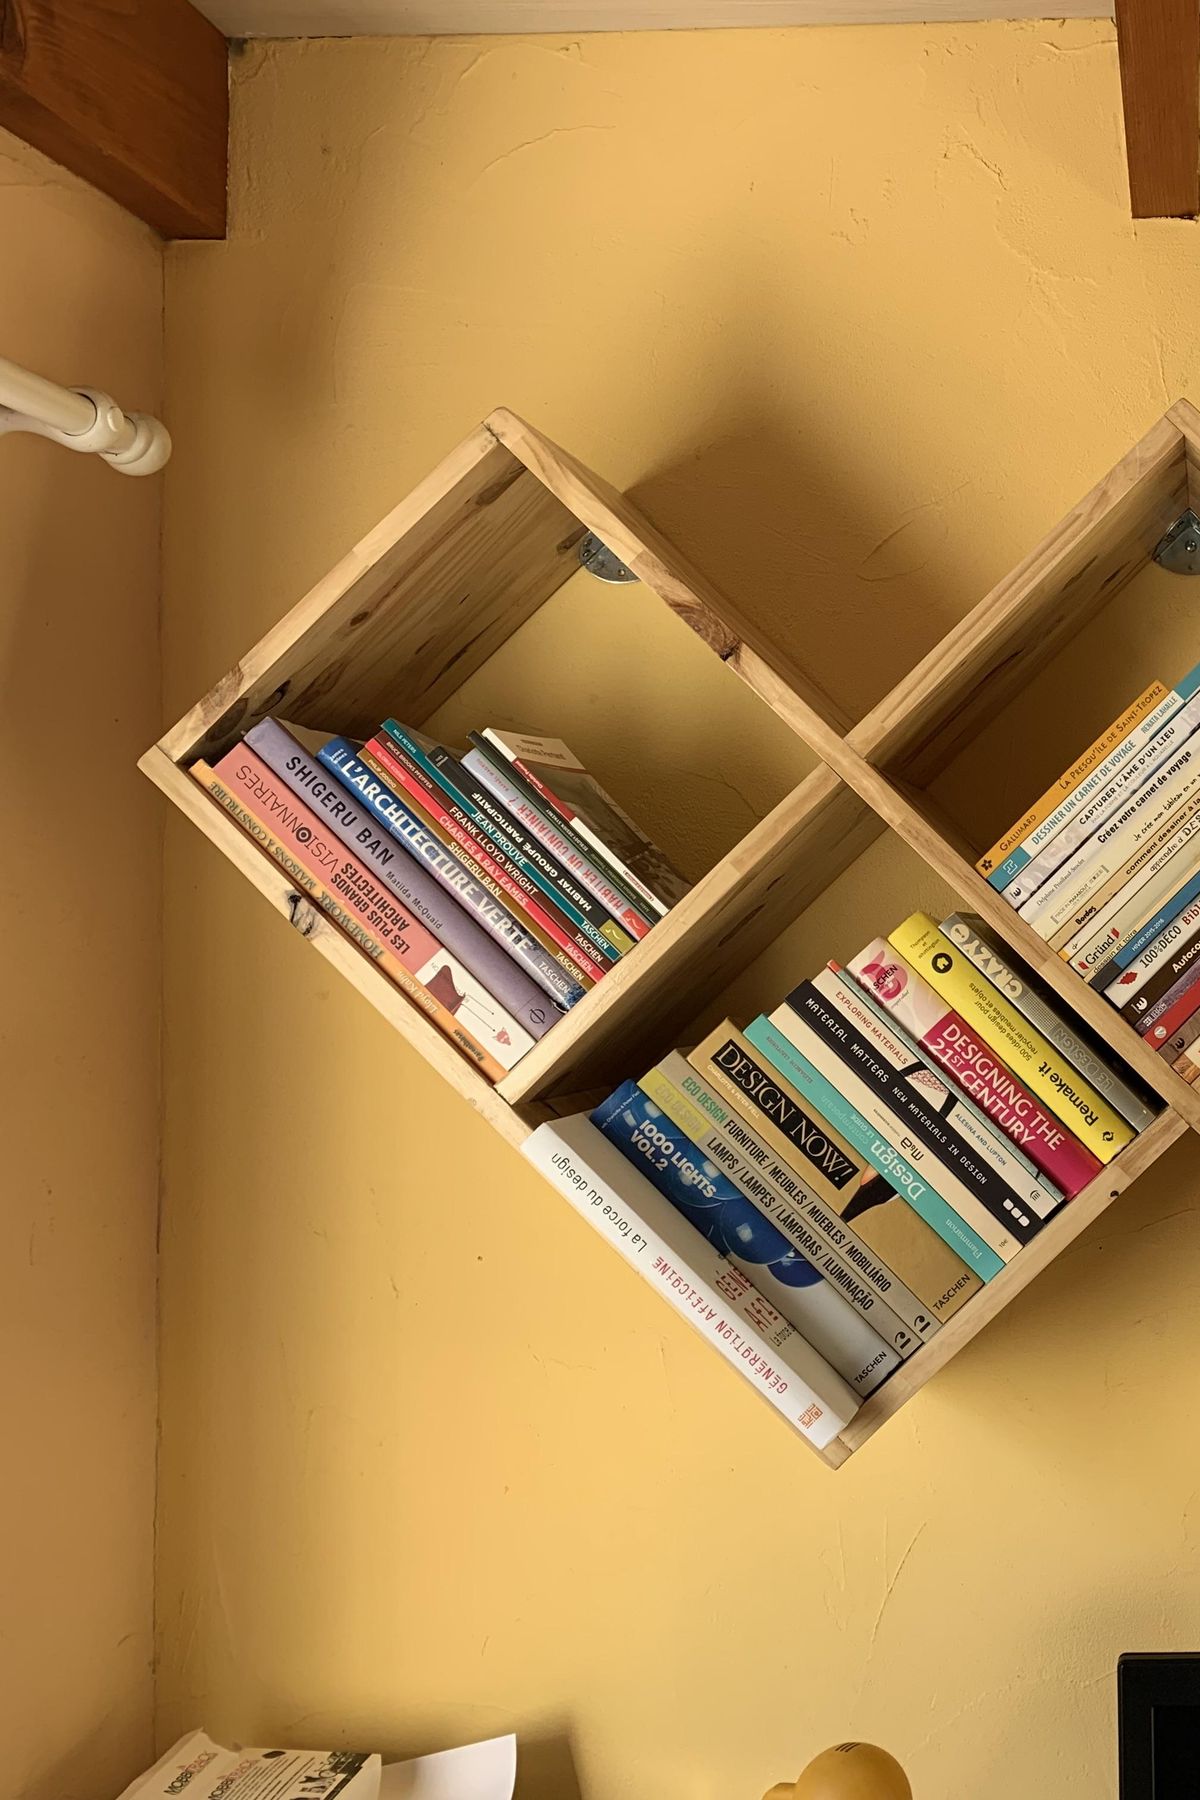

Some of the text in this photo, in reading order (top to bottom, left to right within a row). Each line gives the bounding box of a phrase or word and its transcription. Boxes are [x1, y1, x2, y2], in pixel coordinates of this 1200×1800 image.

[1030, 739, 1136, 845] DESSINER CARNET VOYAGE
[1078, 726, 1176, 825] CAPTURER LIEU
[1096, 750, 1193, 844] Créez votre carnet voyage
[1162, 790, 1183, 811] tableau
[233, 762, 341, 873] VISIONNAIRES
[284, 754, 394, 867] SHIGERU BAN
[470, 809, 495, 834] JEAN
[515, 802, 570, 858] CONTAINER
[1124, 841, 1158, 875] comment
[1156, 810, 1188, 842] dessiner
[206, 780, 384, 959] HOMEWORK MAISONS CONSTRUIRE
[340, 757, 533, 956] L'ARCHITECTURE VERTE
[438, 814, 528, 906] CHARLES RAY EAMES
[447, 840, 502, 897] SHIGERU BAN
[448, 805, 538, 897] FRANK LLOYD WRIGHT
[470, 789, 592, 912] HABITAT GROUPÉ PARTICIPATIF
[564, 851, 585, 872] UN
[329, 872, 410, 954] LES PLUS GRANDS
[339, 861, 410, 933] ARCHITECTES
[384, 870, 413, 899] Matilda
[410, 897, 443, 930] McQuaid
[579, 866, 625, 913] HABITER
[555, 951, 584, 981] TASCHEN
[564, 942, 593, 972] TASCHEN
[574, 932, 603, 962] TASCHEN
[580, 920, 609, 950] TASCHEN
[1083, 933, 1115, 965] Gründ
[537, 961, 570, 995] TASCHEN
[835, 989, 873, 1029] EXPLORING
[870, 1025, 909, 1066] MATERIALS
[715, 1042, 796, 1126] DESIGN
[788, 1117, 853, 1184] NOW!
[804, 996, 849, 1044] MATERIAL
[849, 1042, 890, 1084] MATTERS
[907, 1102, 948, 1144] MATERIALS
[959, 1155, 988, 1185] DESIGN
[940, 1021, 1066, 1151] DESIGNING THE
[956, 1066, 1035, 1150] CENTURY
[1046, 1070, 1099, 1126] Remake
[954, 1111, 978, 1136] ALESINA
[548, 1149, 648, 1253] La force du design
[670, 1149, 718, 1199] LIGHTS
[696, 1091, 894, 1293] DESIGN FURNITURE MEUBLES MUEBLES MOBILIÁRIO
[865, 1135, 929, 1202] Design
[706, 1136, 877, 1314] LAMPS LAMPES LÁMPARAS ILUMINAÇÃO
[943, 1217, 982, 1259] Flammarion
[931, 1273, 971, 1311] TASCHEN
[853, 1351, 887, 1384] TASCHEN
